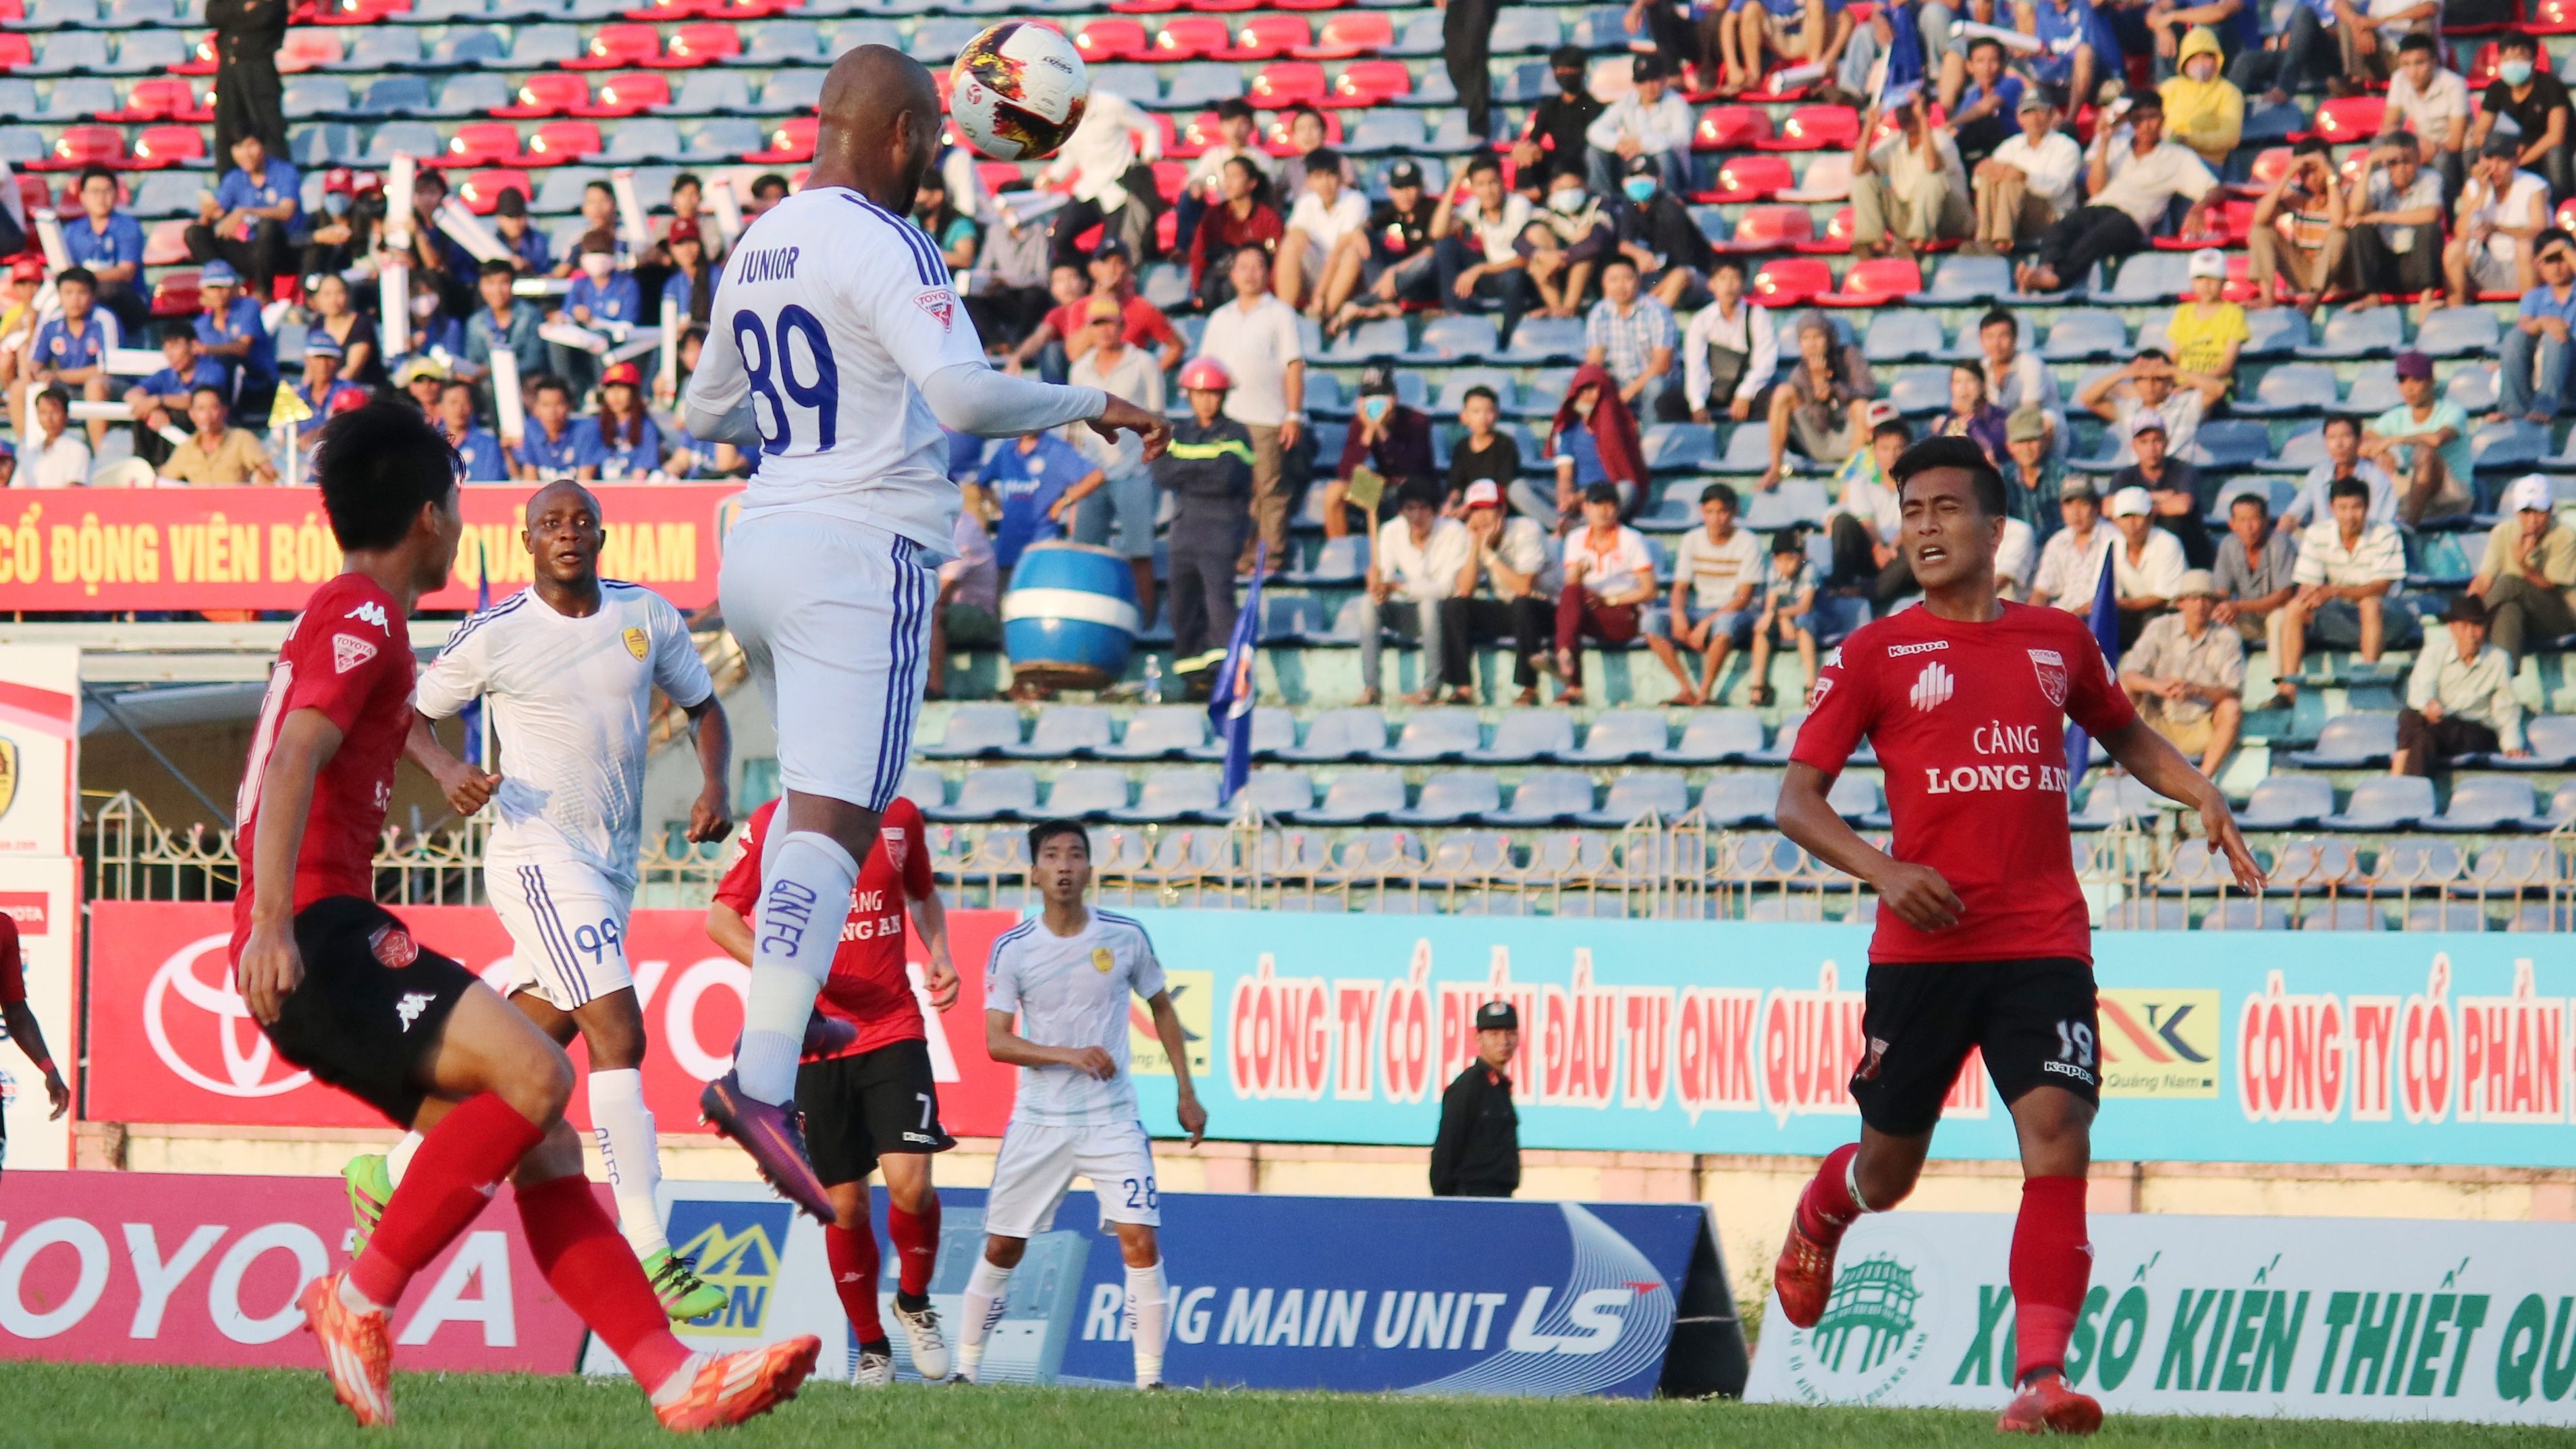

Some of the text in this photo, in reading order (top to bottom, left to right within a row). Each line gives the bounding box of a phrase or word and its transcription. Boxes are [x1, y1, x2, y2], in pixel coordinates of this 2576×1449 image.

[738, 247, 799, 285] JUNIOR
[732, 304, 838, 456] 89
[51, 512, 160, 597] ĐỘNG
[168, 511, 261, 583] VIÊN
[271, 511, 345, 583] BÓN
[599, 522, 697, 583] NAM
[337, 637, 373, 656] TOYOTA
[1888, 640, 1950, 658] Kappa
[1973, 720, 2039, 755] CẢNG
[1926, 765, 2068, 795] LONG AN
[761, 879, 817, 958] QNFC
[849, 888, 883, 914] ẢNG
[574, 918, 624, 965] 99
[839, 921, 874, 942] NG
[1229, 952, 1331, 1101] CÔNG
[1333, 979, 1384, 1101] TY
[1380, 938, 1432, 1105] CỔ
[1540, 947, 1617, 1110] ĐẦU
[1678, 985, 1763, 1128] QNK
[1761, 959, 1868, 1130] QUẢN
[2056, 1018, 2093, 1067] 19
[2237, 969, 2346, 1123] CÔNG
[2348, 995, 2401, 1121] TY
[2398, 952, 2454, 1124] CỔ
[2457, 958, 2565, 1124] PHẦN
[2044, 1060, 2094, 1085] Kappa
[915, 1092, 932, 1130] 7
[1123, 1176, 1158, 1210] 28
[0, 1217, 517, 1348] OYOA
[1217, 1287, 1368, 1348] MAIN
[1373, 1290, 1508, 1350] UNIT
[1507, 1286, 1634, 1355] LS
[2064, 1251, 2162, 1392] SỐ
[2154, 1253, 2311, 1393] KIẾN
[2313, 1256, 2492, 1397] THIẾT
